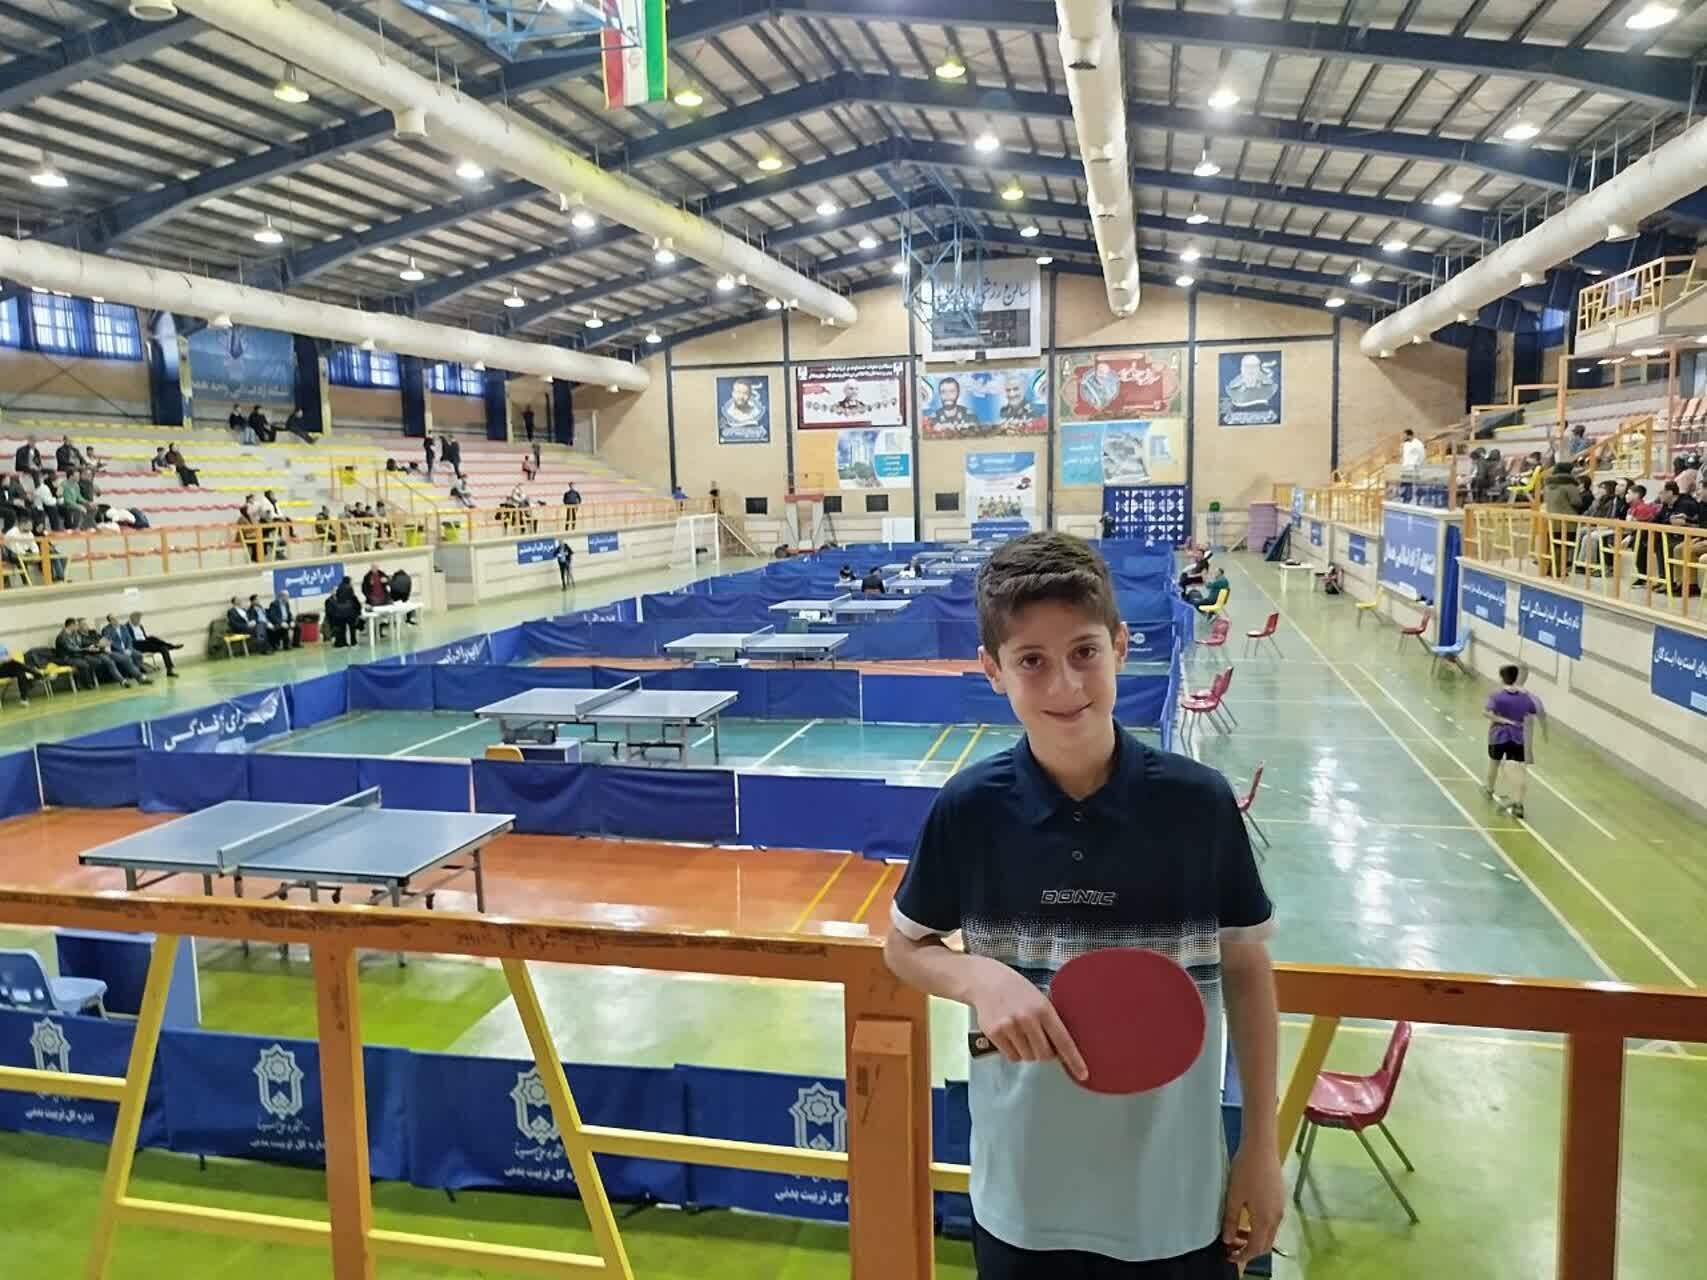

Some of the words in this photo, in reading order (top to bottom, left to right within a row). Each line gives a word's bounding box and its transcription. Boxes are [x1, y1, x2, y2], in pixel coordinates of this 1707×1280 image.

[1041, 889, 1116, 906] DONIC
[774, 1186, 799, 1203] بدنی
[800, 1188, 827, 1205] تربیت
